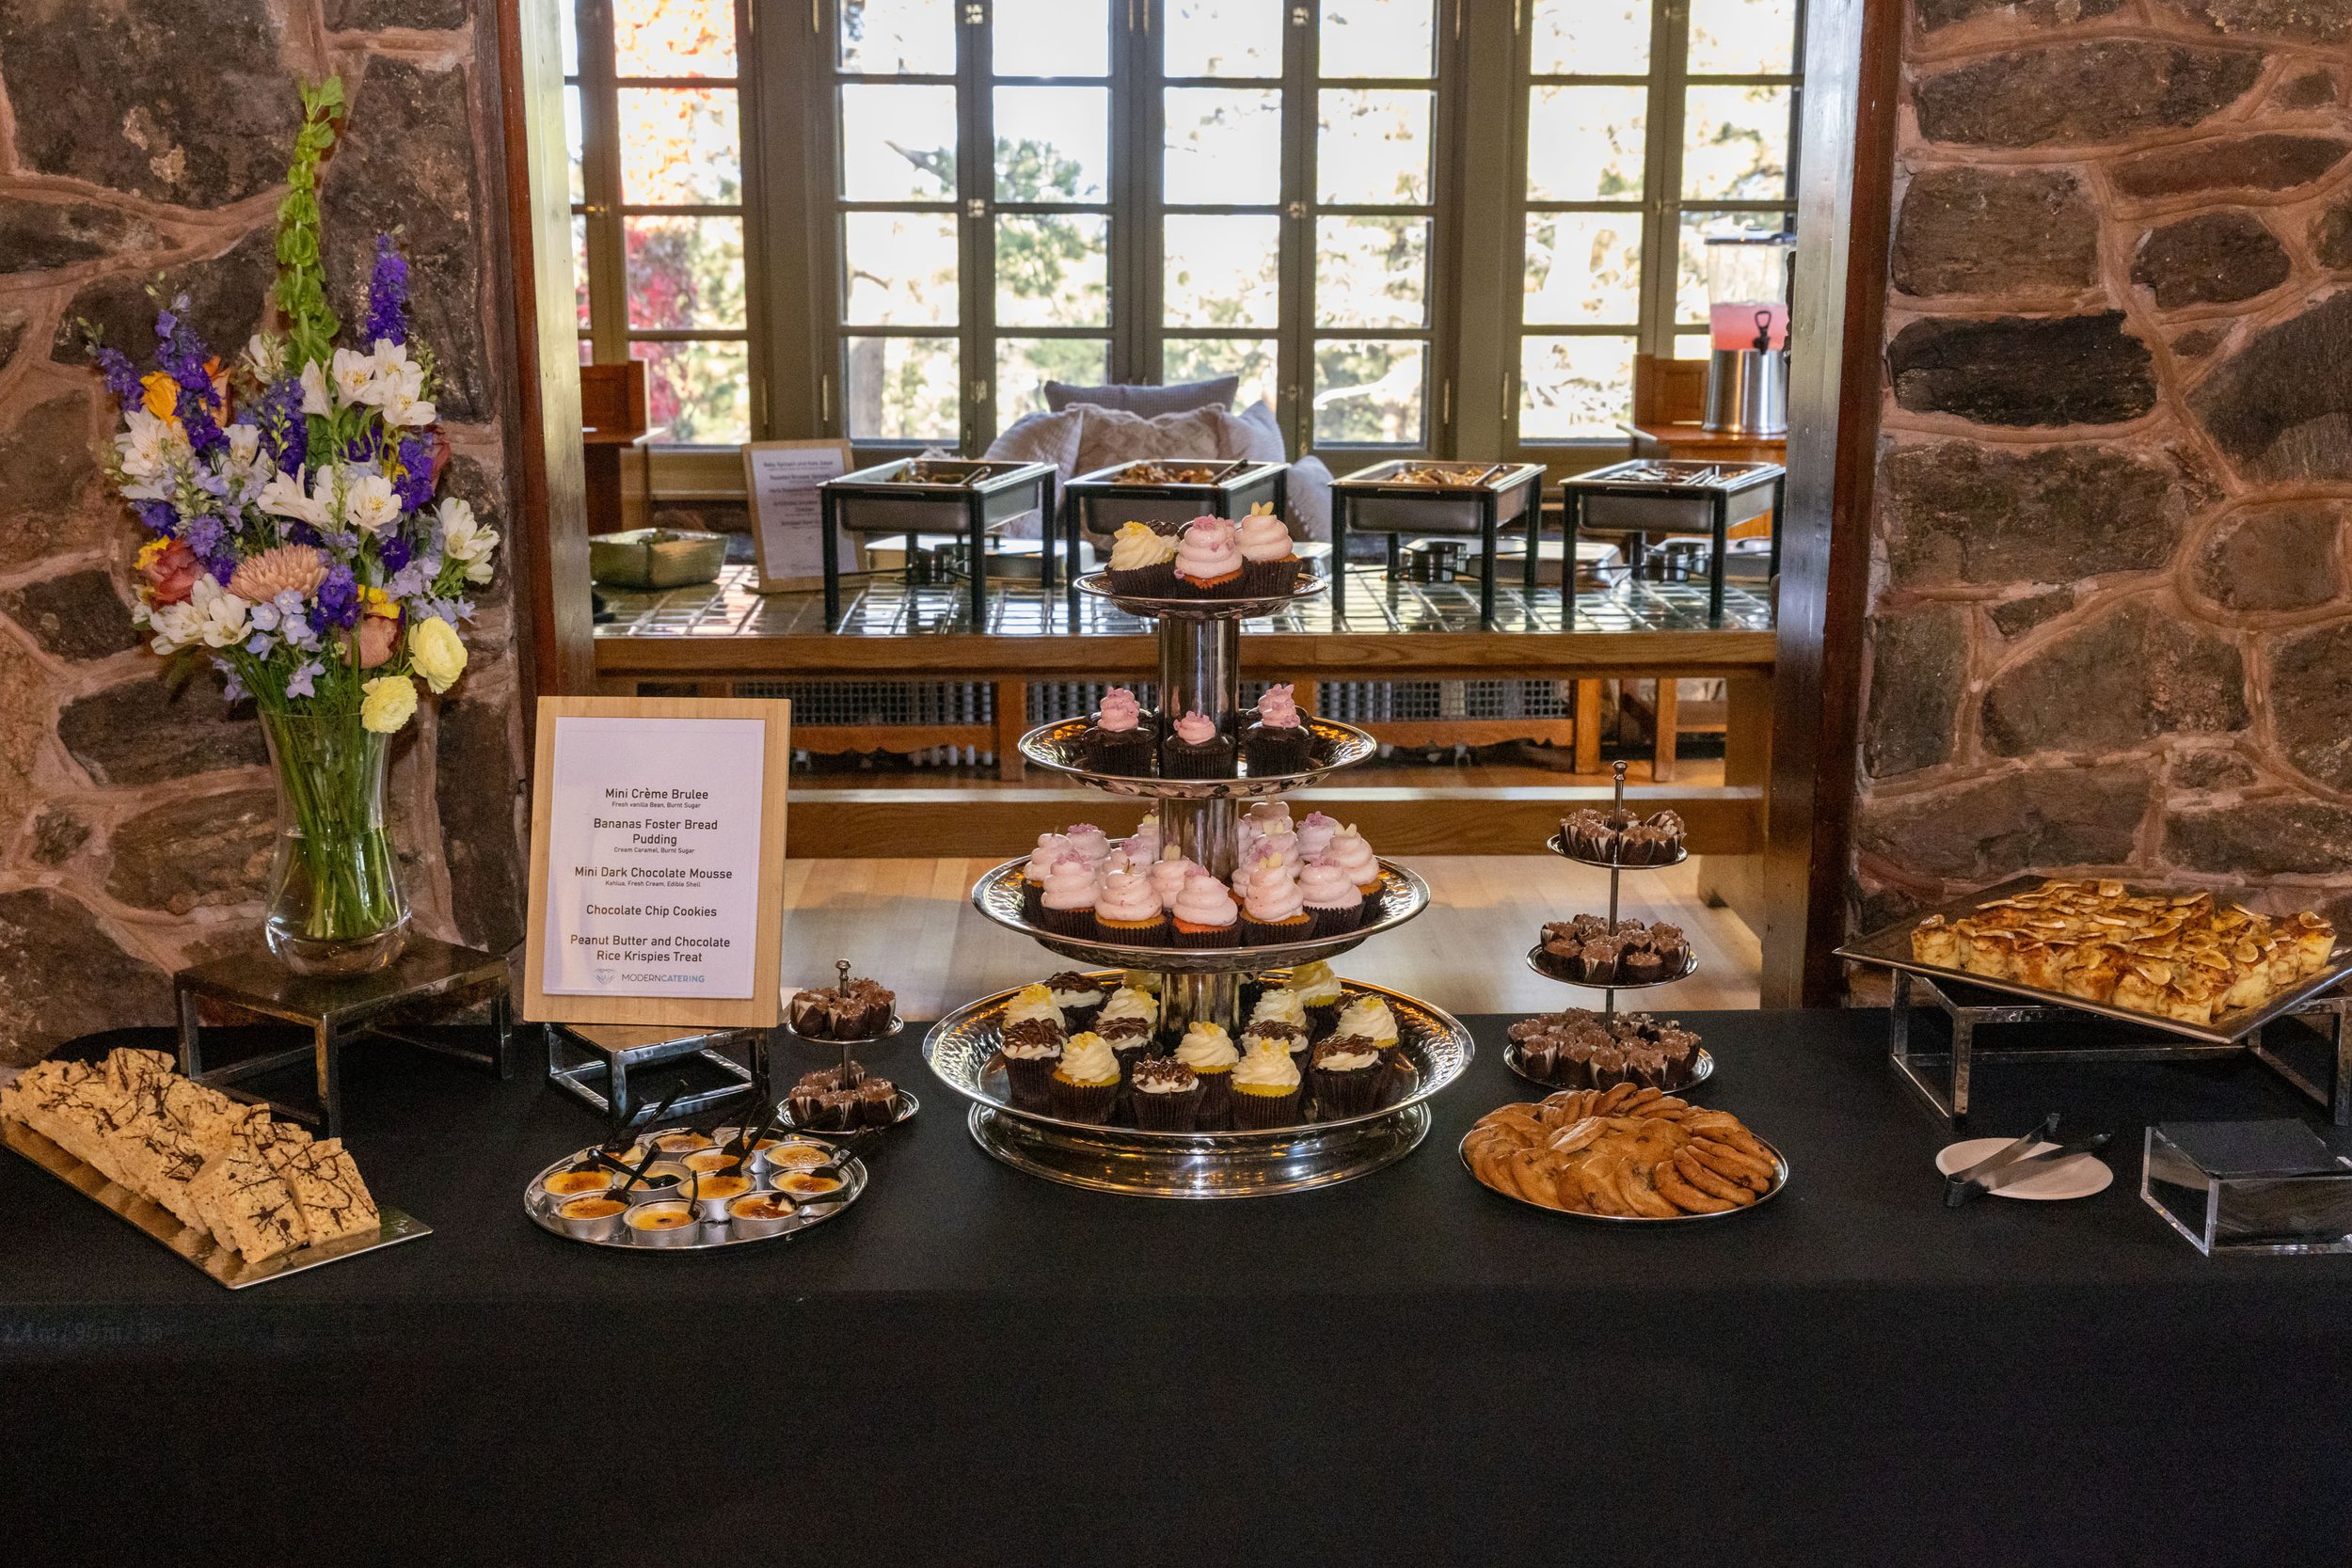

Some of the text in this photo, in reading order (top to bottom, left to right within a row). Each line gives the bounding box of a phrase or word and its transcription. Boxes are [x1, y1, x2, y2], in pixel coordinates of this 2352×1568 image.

[606, 787, 708, 800] Mini Crème Brulee
[684, 801, 701, 810] Sugar
[594, 817, 718, 830] Bananas Foster Bread
[632, 833, 677, 847] Pudding
[575, 866, 732, 879] Mini Dark Chocolate Mousse
[586, 904, 717, 918] Chocolate Chip Cookies
[570, 934, 730, 948] Peanut Butter and Chocolate
[596, 950, 702, 963] Rice Krispies Treat
